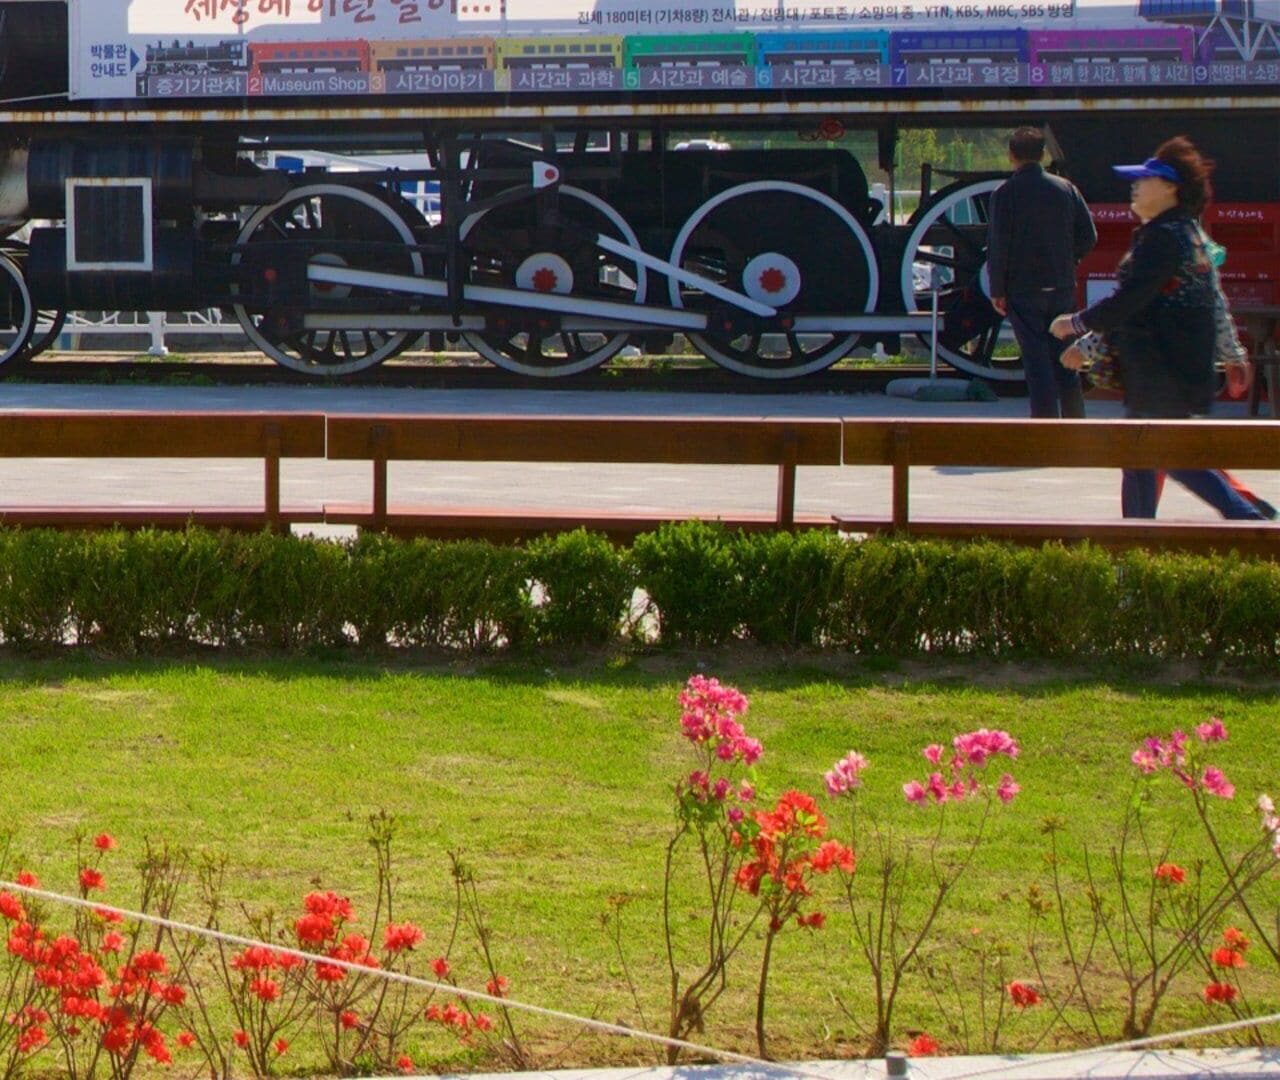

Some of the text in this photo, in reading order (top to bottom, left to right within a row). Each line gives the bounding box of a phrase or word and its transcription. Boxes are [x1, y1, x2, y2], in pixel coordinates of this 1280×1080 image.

[578, 9, 603, 25] 전체
[606, 9, 652, 24] 180미터
[655, 8, 709, 24] (기차8량)
[711, 7, 750, 23] 전시관
[760, 6, 799, 22] 전망대
[809, 6, 849, 21] 포토존
[858, 5, 899, 20] 소망의
[901, 5, 915, 20] 종
[925, 4, 953, 19] YTN,
[955, 4, 984, 19] KBS,
[986, 4, 1018, 19] MBC,
[1021, 4, 1045, 18] SBS
[1047, 3, 1074, 19] 방영
[91, 43, 128, 60] 박물관
[91, 62, 129, 78] 안내도
[626, 69, 748, 87] 5 시간과 예술
[758, 67, 881, 86] 6 시간과 추억
[893, 65, 1020, 84] 7 시간과 열정
[1031, 66, 1044, 82] 8
[1050, 66, 1074, 83] 함께
[1077, 65, 1090, 83] 한
[1122, 65, 1147, 83] 함께
[1165, 65, 1189, 82] 시간
[1194, 65, 1208, 80] 9
[138, 76, 241, 95] 1 증기기관차
[249, 75, 367, 93] 2 Museum Shop
[371, 72, 484, 90] 3 시간이야기
[518, 72, 572, 90] 시간과
[578, 71, 616, 89] 과학
